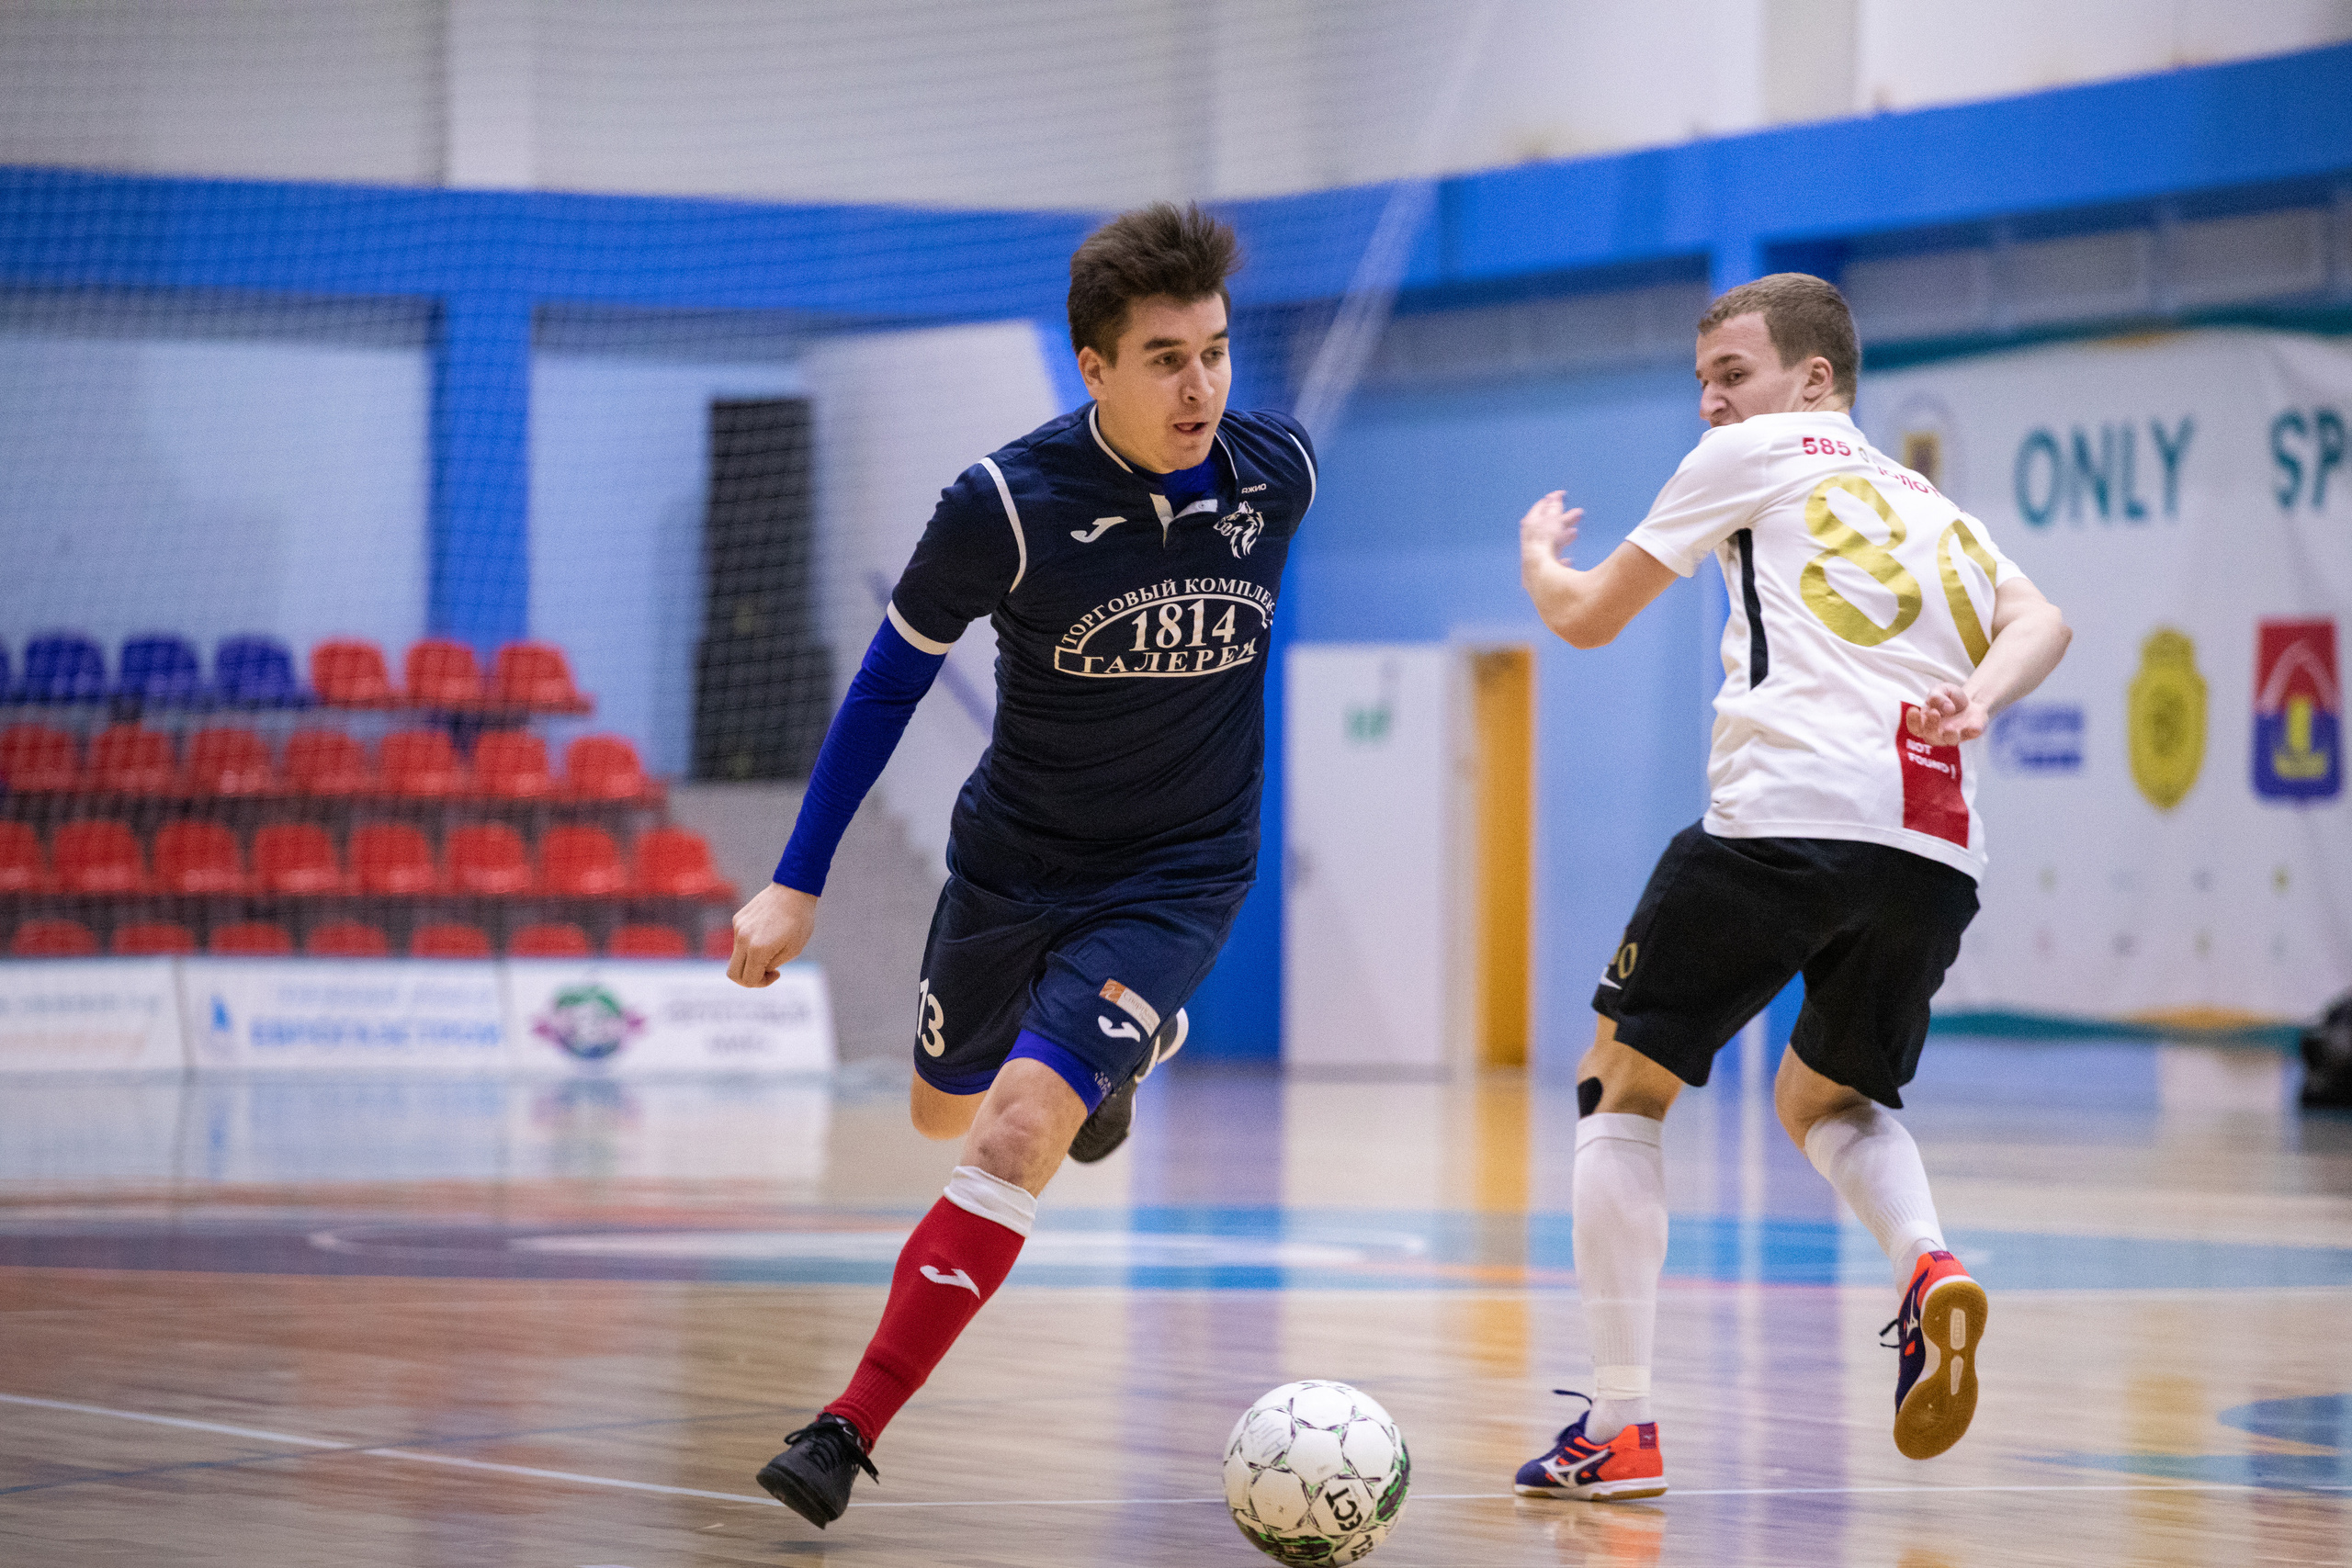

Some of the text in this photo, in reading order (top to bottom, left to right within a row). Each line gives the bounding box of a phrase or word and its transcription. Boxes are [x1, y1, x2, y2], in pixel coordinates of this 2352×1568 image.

[1802, 436, 1851, 457] 585
[2015, 417, 2195, 529] ONLY
[1060, 577, 1275, 647] ТОРГОВЫЙ КОМПЛЕК
[1128, 598, 1236, 653] 1814
[1081, 637, 1258, 674] ГАЛЕРЕЯ
